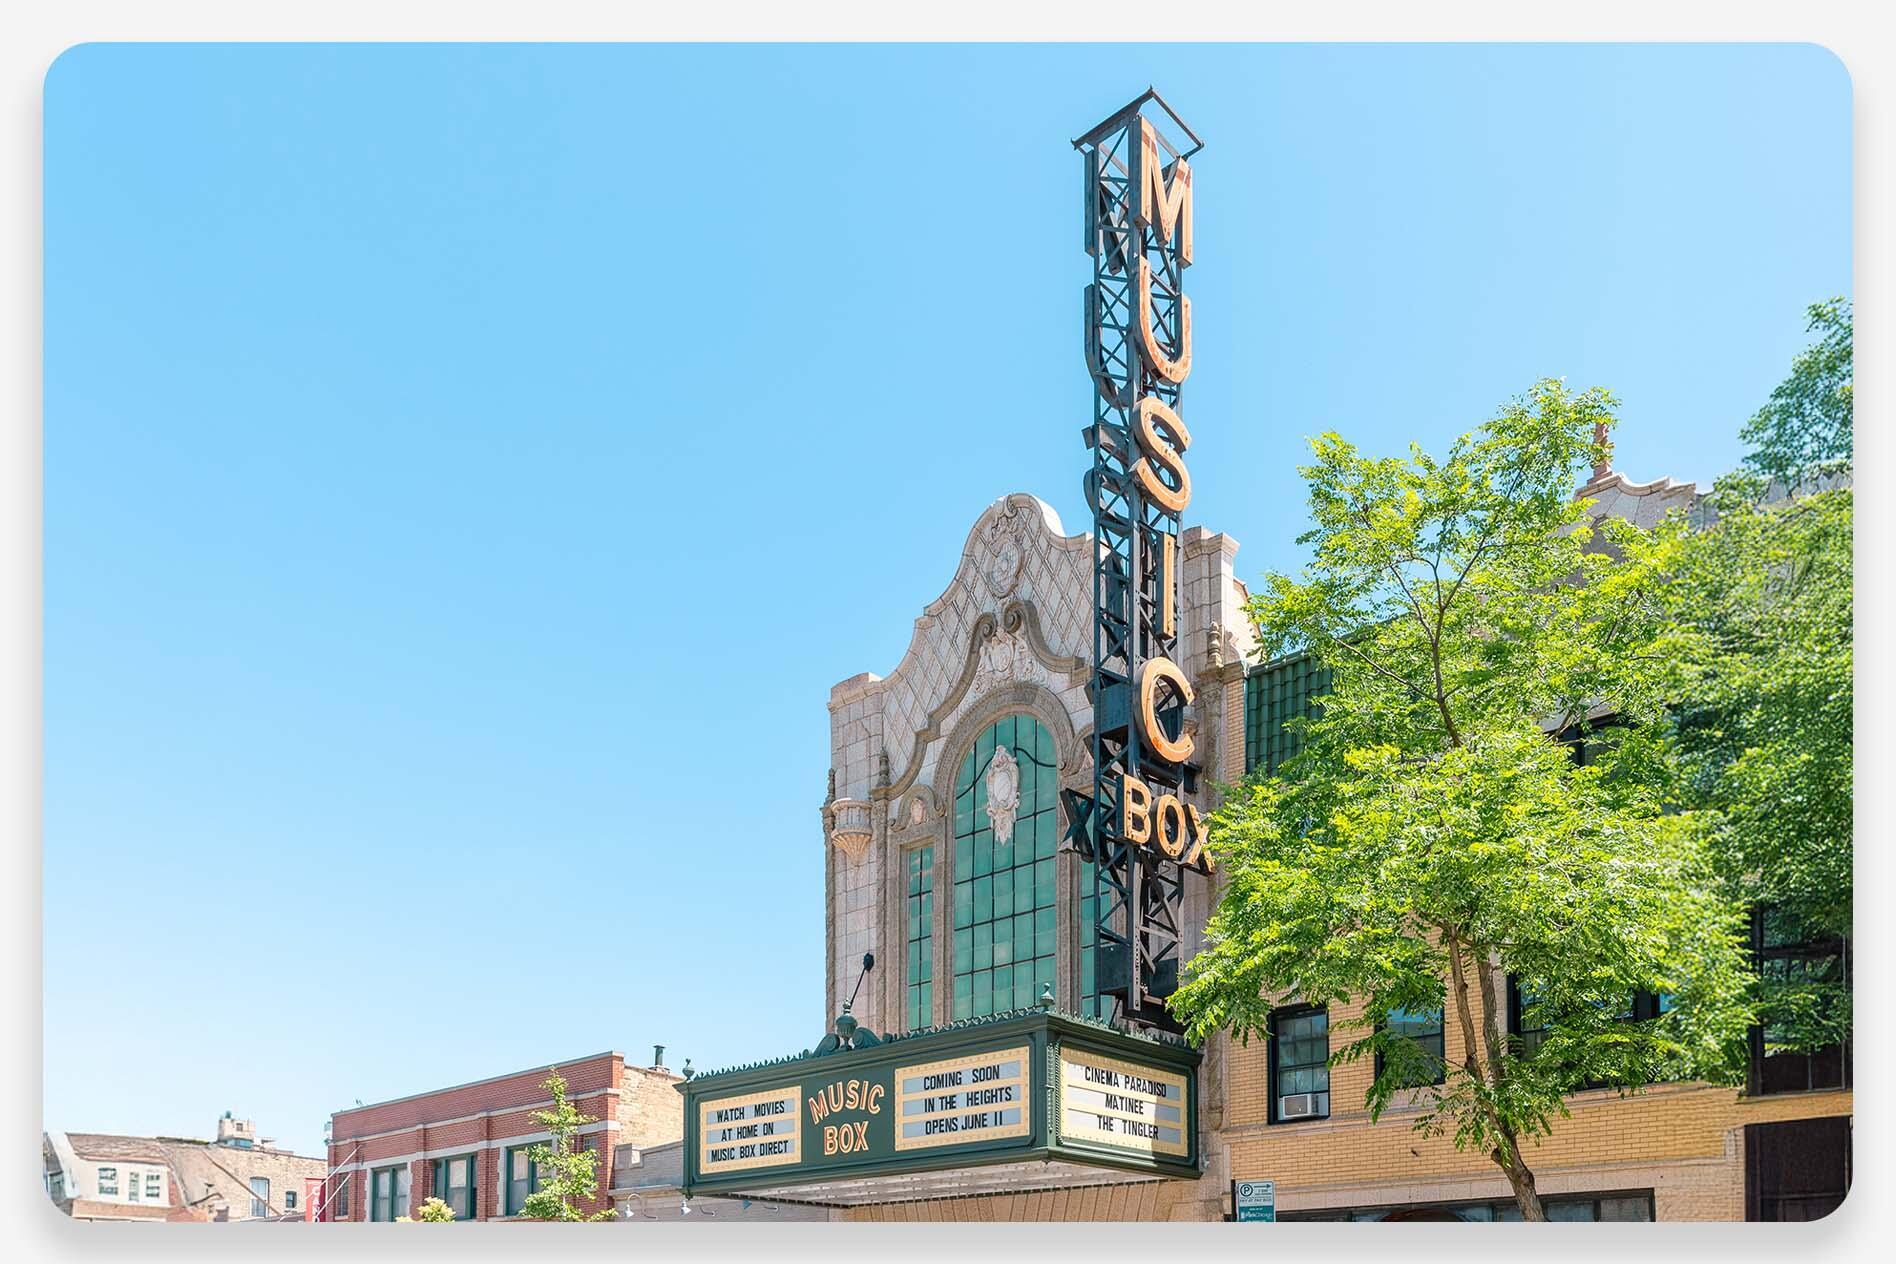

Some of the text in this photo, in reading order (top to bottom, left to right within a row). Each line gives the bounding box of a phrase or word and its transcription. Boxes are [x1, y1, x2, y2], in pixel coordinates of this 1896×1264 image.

[1134, 113, 1195, 764] MUSIC
[1123, 773, 1216, 874] BOX
[923, 1064, 1000, 1091] COMING SOON
[1084, 1066, 1167, 1098] CINEMA PARADISO
[716, 1100, 785, 1123] WATCH MOVIES
[808, 1079, 885, 1126] MUSIC
[924, 1086, 1012, 1113] IN THE HEIGHTS
[1104, 1093, 1144, 1115] MATINEE
[721, 1121, 774, 1142] AT HOME ON
[925, 1117, 959, 1135] OPENS
[961, 1112, 988, 1131] JUNE
[1097, 1115, 1160, 1141] THE TINGLER
[711, 1140, 789, 1163] MUSIC BOX DIRECT
[824, 1121, 869, 1155] BOX
